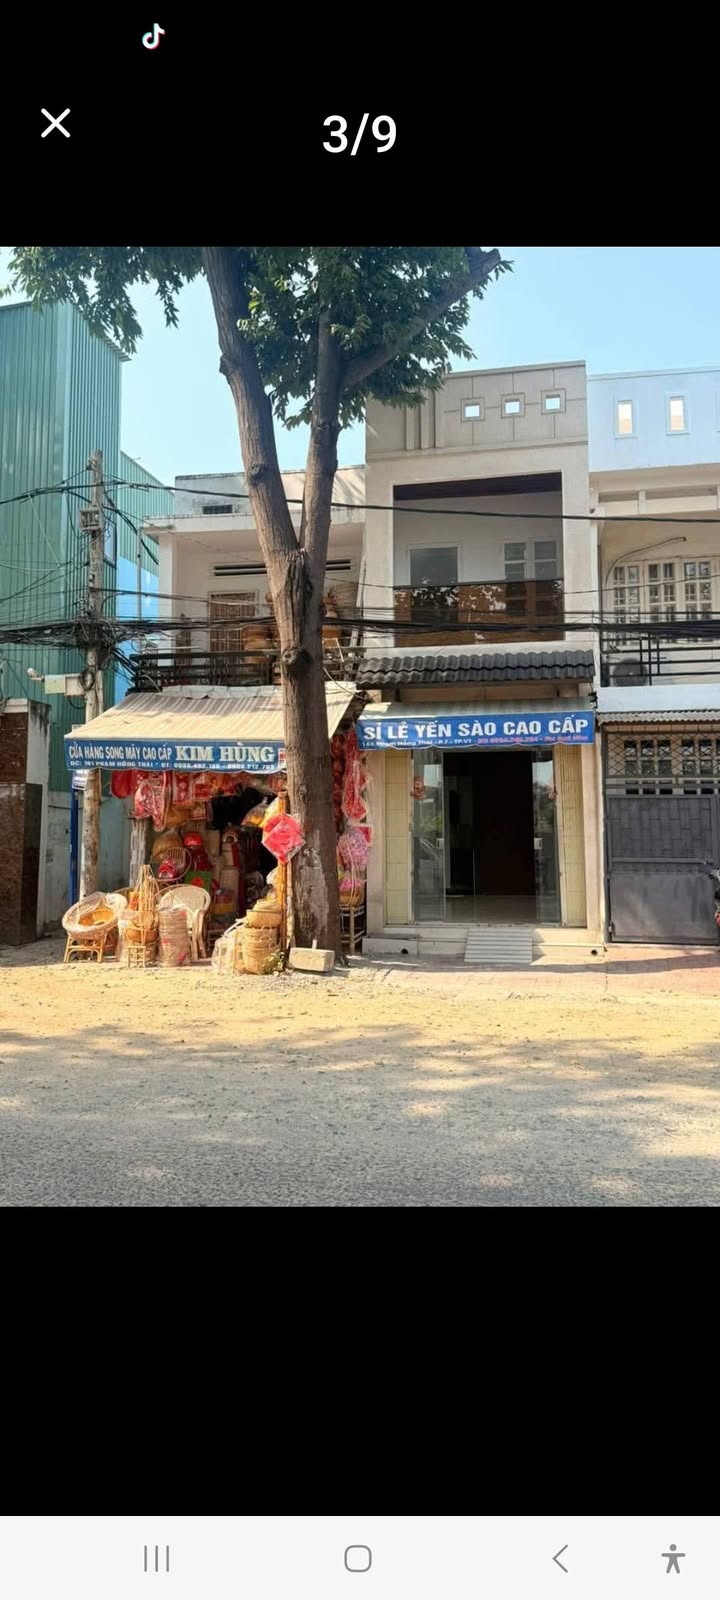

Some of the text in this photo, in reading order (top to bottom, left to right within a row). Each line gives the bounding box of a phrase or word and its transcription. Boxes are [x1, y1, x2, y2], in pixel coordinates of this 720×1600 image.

[363, 714, 588, 740] SỈ LẺ YẾN SÀO CAO CẤP
[68, 741, 173, 761] CỬA HÀNG SONG MÂY CAO CẤP
[174, 741, 276, 763] KIM HÙNG
